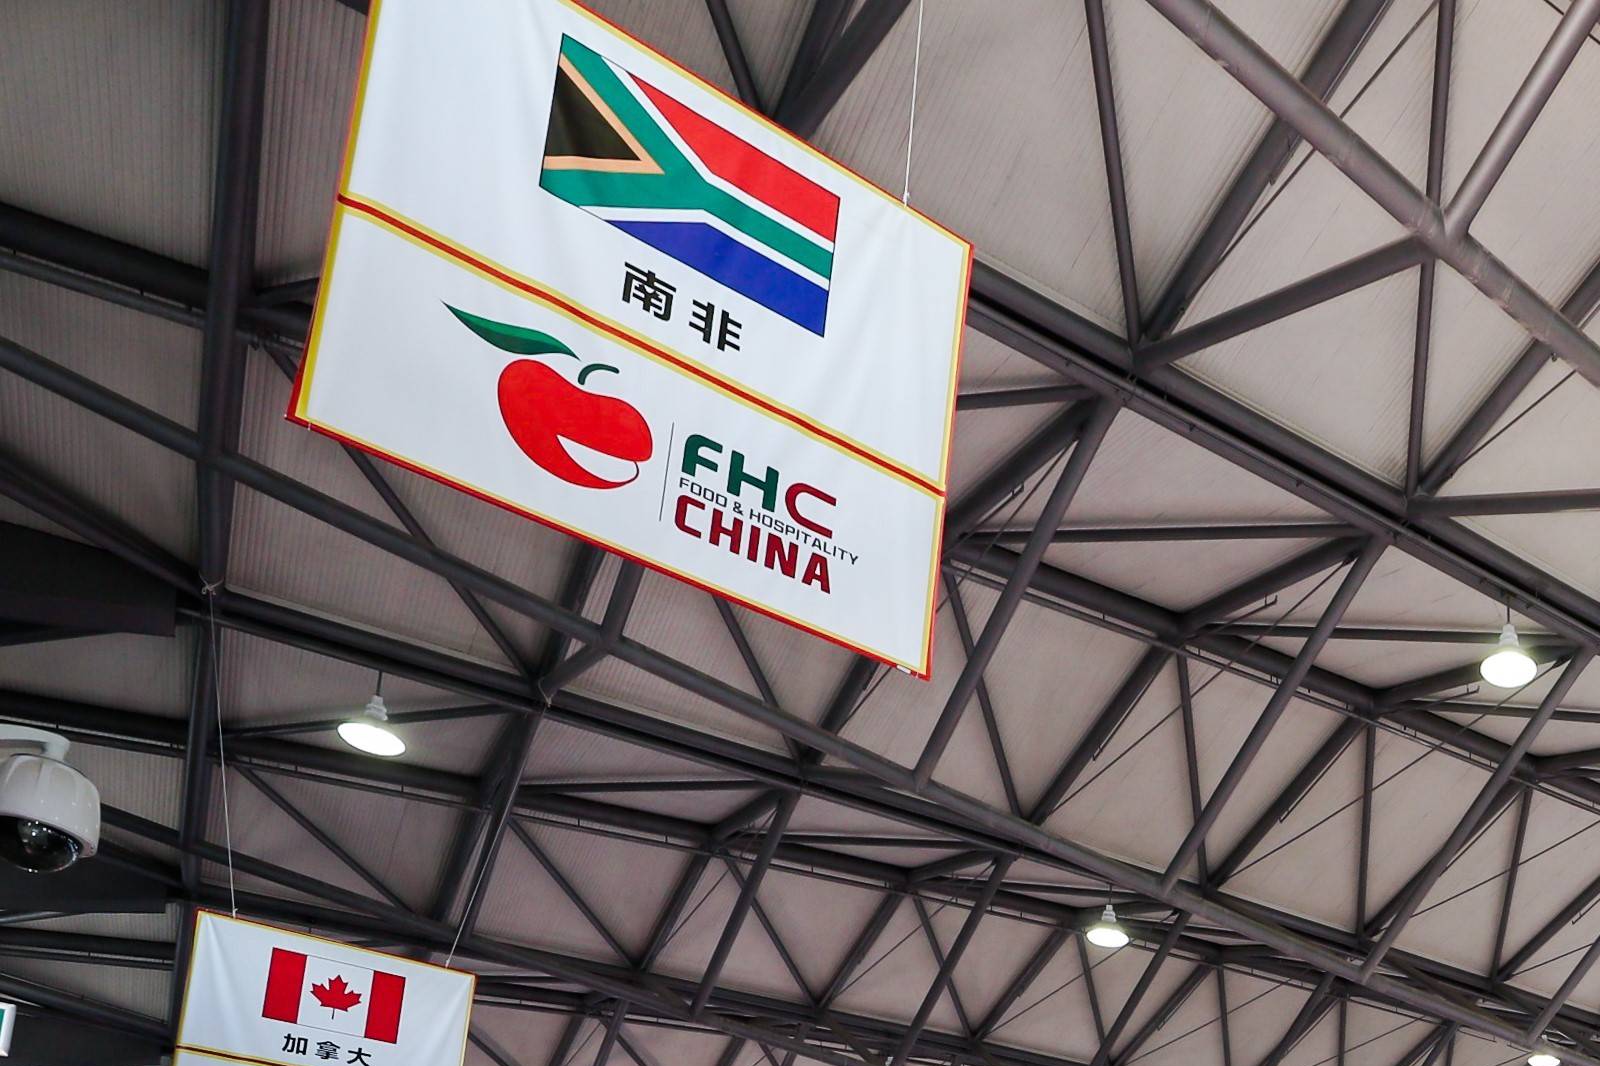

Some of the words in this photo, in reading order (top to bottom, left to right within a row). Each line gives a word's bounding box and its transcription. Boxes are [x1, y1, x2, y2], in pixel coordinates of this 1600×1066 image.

[622, 261, 743, 352] 南非
[679, 477, 728, 511] FOOD
[732, 500, 745, 516] &
[749, 508, 859, 565] HOSPITALITY
[681, 433, 837, 539] FHC
[674, 495, 831, 594] CHINA
[282, 1033, 372, 1066] 加拿大
